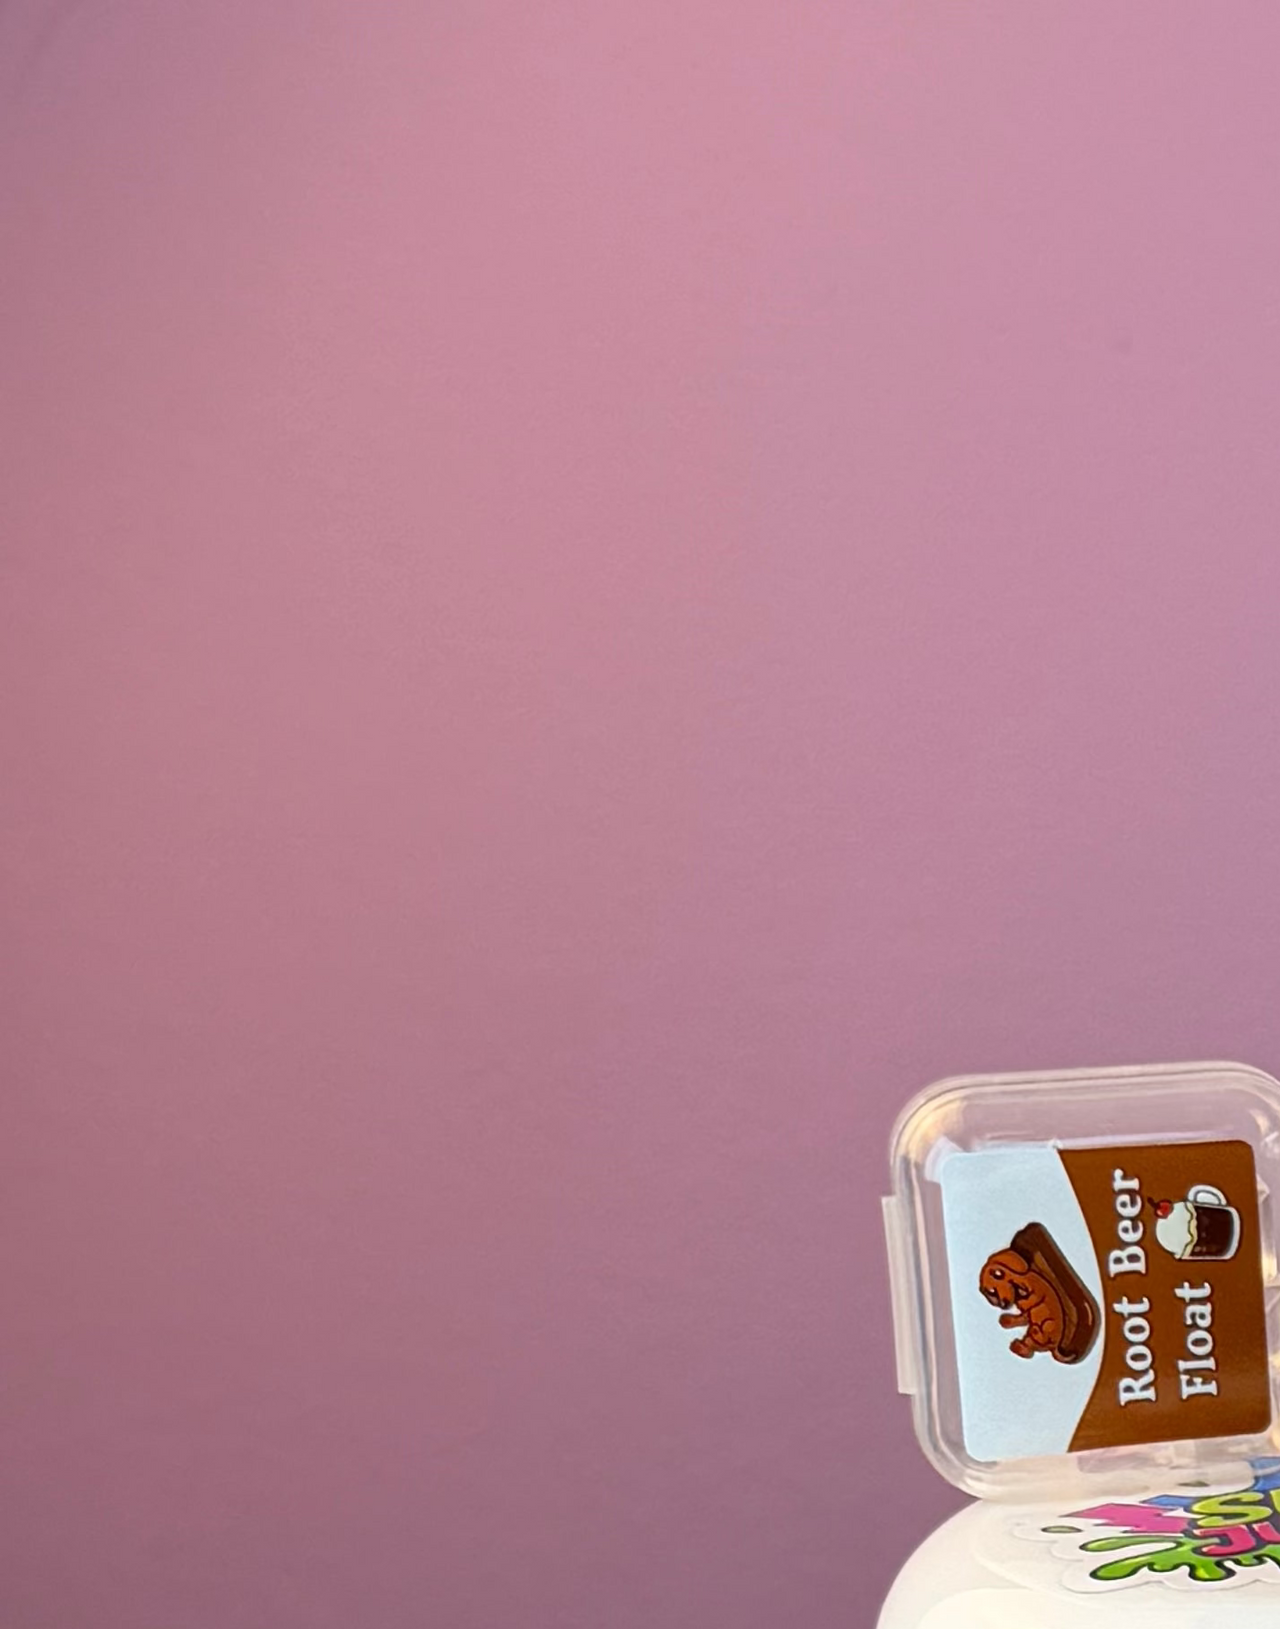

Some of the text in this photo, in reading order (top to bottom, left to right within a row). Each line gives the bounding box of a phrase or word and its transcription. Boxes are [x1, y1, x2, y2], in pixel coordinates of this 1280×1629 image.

[1107, 1167, 1158, 1407] Root Beer
[1174, 1280, 1219, 1401] Float
